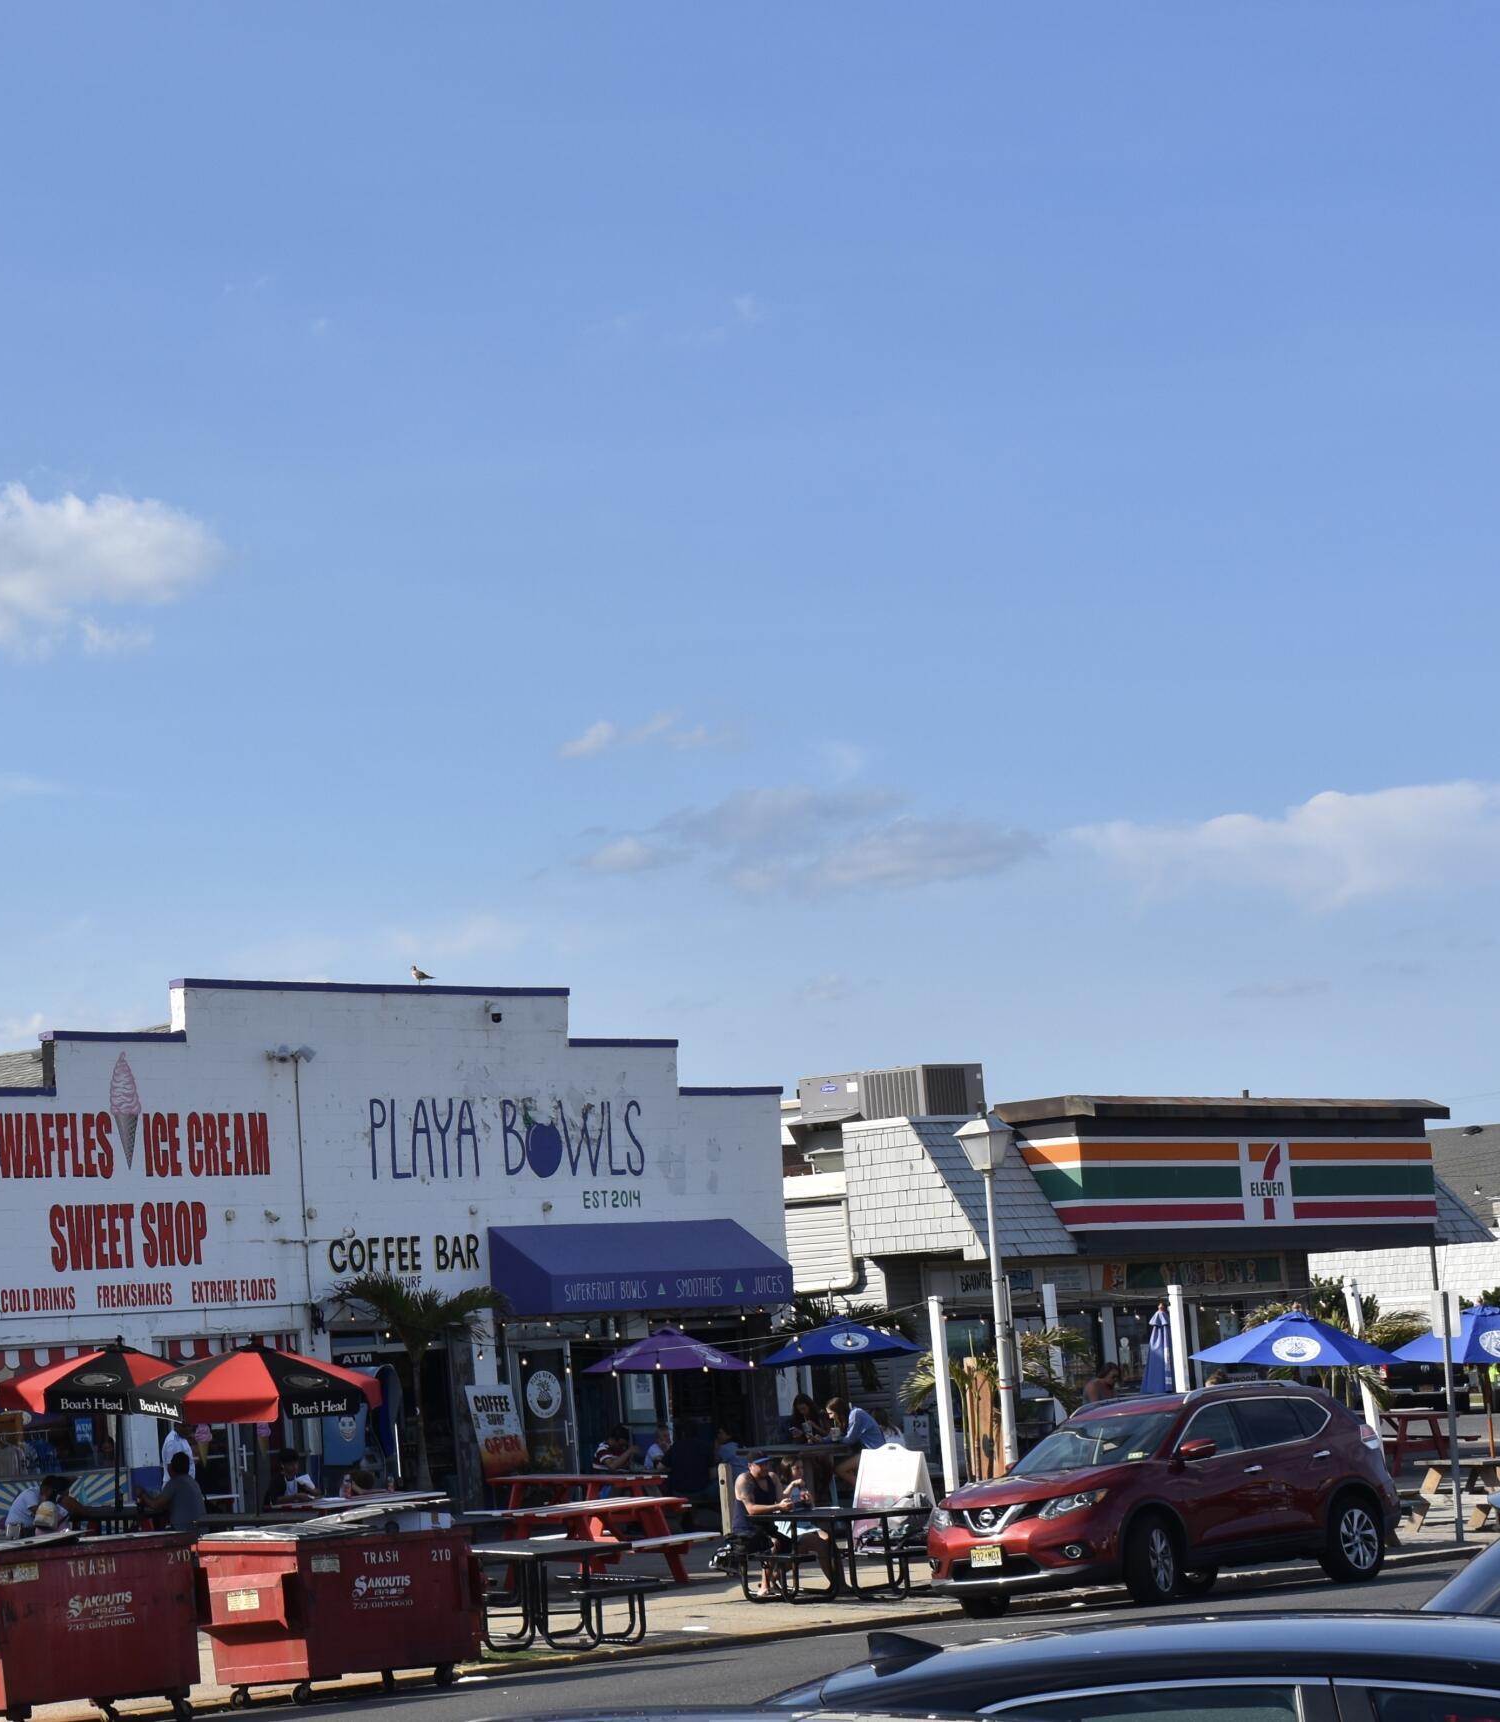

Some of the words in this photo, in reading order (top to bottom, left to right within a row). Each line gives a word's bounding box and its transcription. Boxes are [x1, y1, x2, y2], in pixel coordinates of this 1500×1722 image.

[143, 1113, 183, 1177] ICE
[187, 1111, 271, 1176] CREAM
[370, 1097, 480, 1180] PLAYA
[502, 1098, 645, 1179] BOWLS
[582, 1190, 610, 1209] EST
[611, 1189, 641, 1208] 2014
[49, 1202, 135, 1272] SWEET
[140, 1200, 207, 1269] SHOP
[329, 1235, 422, 1274] COFFEE
[435, 1233, 480, 1271] BAR
[191, 1279, 238, 1303] EXTREME
[240, 1278, 277, 1302] FLOATS
[399, 1275, 422, 1290] SURF
[564, 1281, 615, 1302] SUPERFRUIT
[620, 1280, 648, 1300] BOWLS
[675, 1276, 723, 1299] SMOOTHIES
[752, 1275, 785, 1295] JUICES
[0, 1288, 32, 1313] COLD
[33, 1286, 76, 1312] DRINKS
[97, 1283, 173, 1308] FREAKSHAKES
[341, 1353, 373, 1364] ATM
[60, 1398, 92, 1410] Boar's
[94, 1398, 122, 1411] Head
[140, 1398, 160, 1414] Boar's
[160, 1402, 179, 1417] Head
[292, 1401, 320, 1416] Boar's
[321, 1399, 347, 1413] Head
[473, 1395, 511, 1413] COFFEE
[484, 1434, 521, 1455] OPEN
[67, 1557, 117, 1578] TRASH
[364, 1550, 399, 1565] TRASH
[352, 1575, 411, 1597] SAKOUTIS
[66, 1591, 133, 1618] SAKOUTIS
